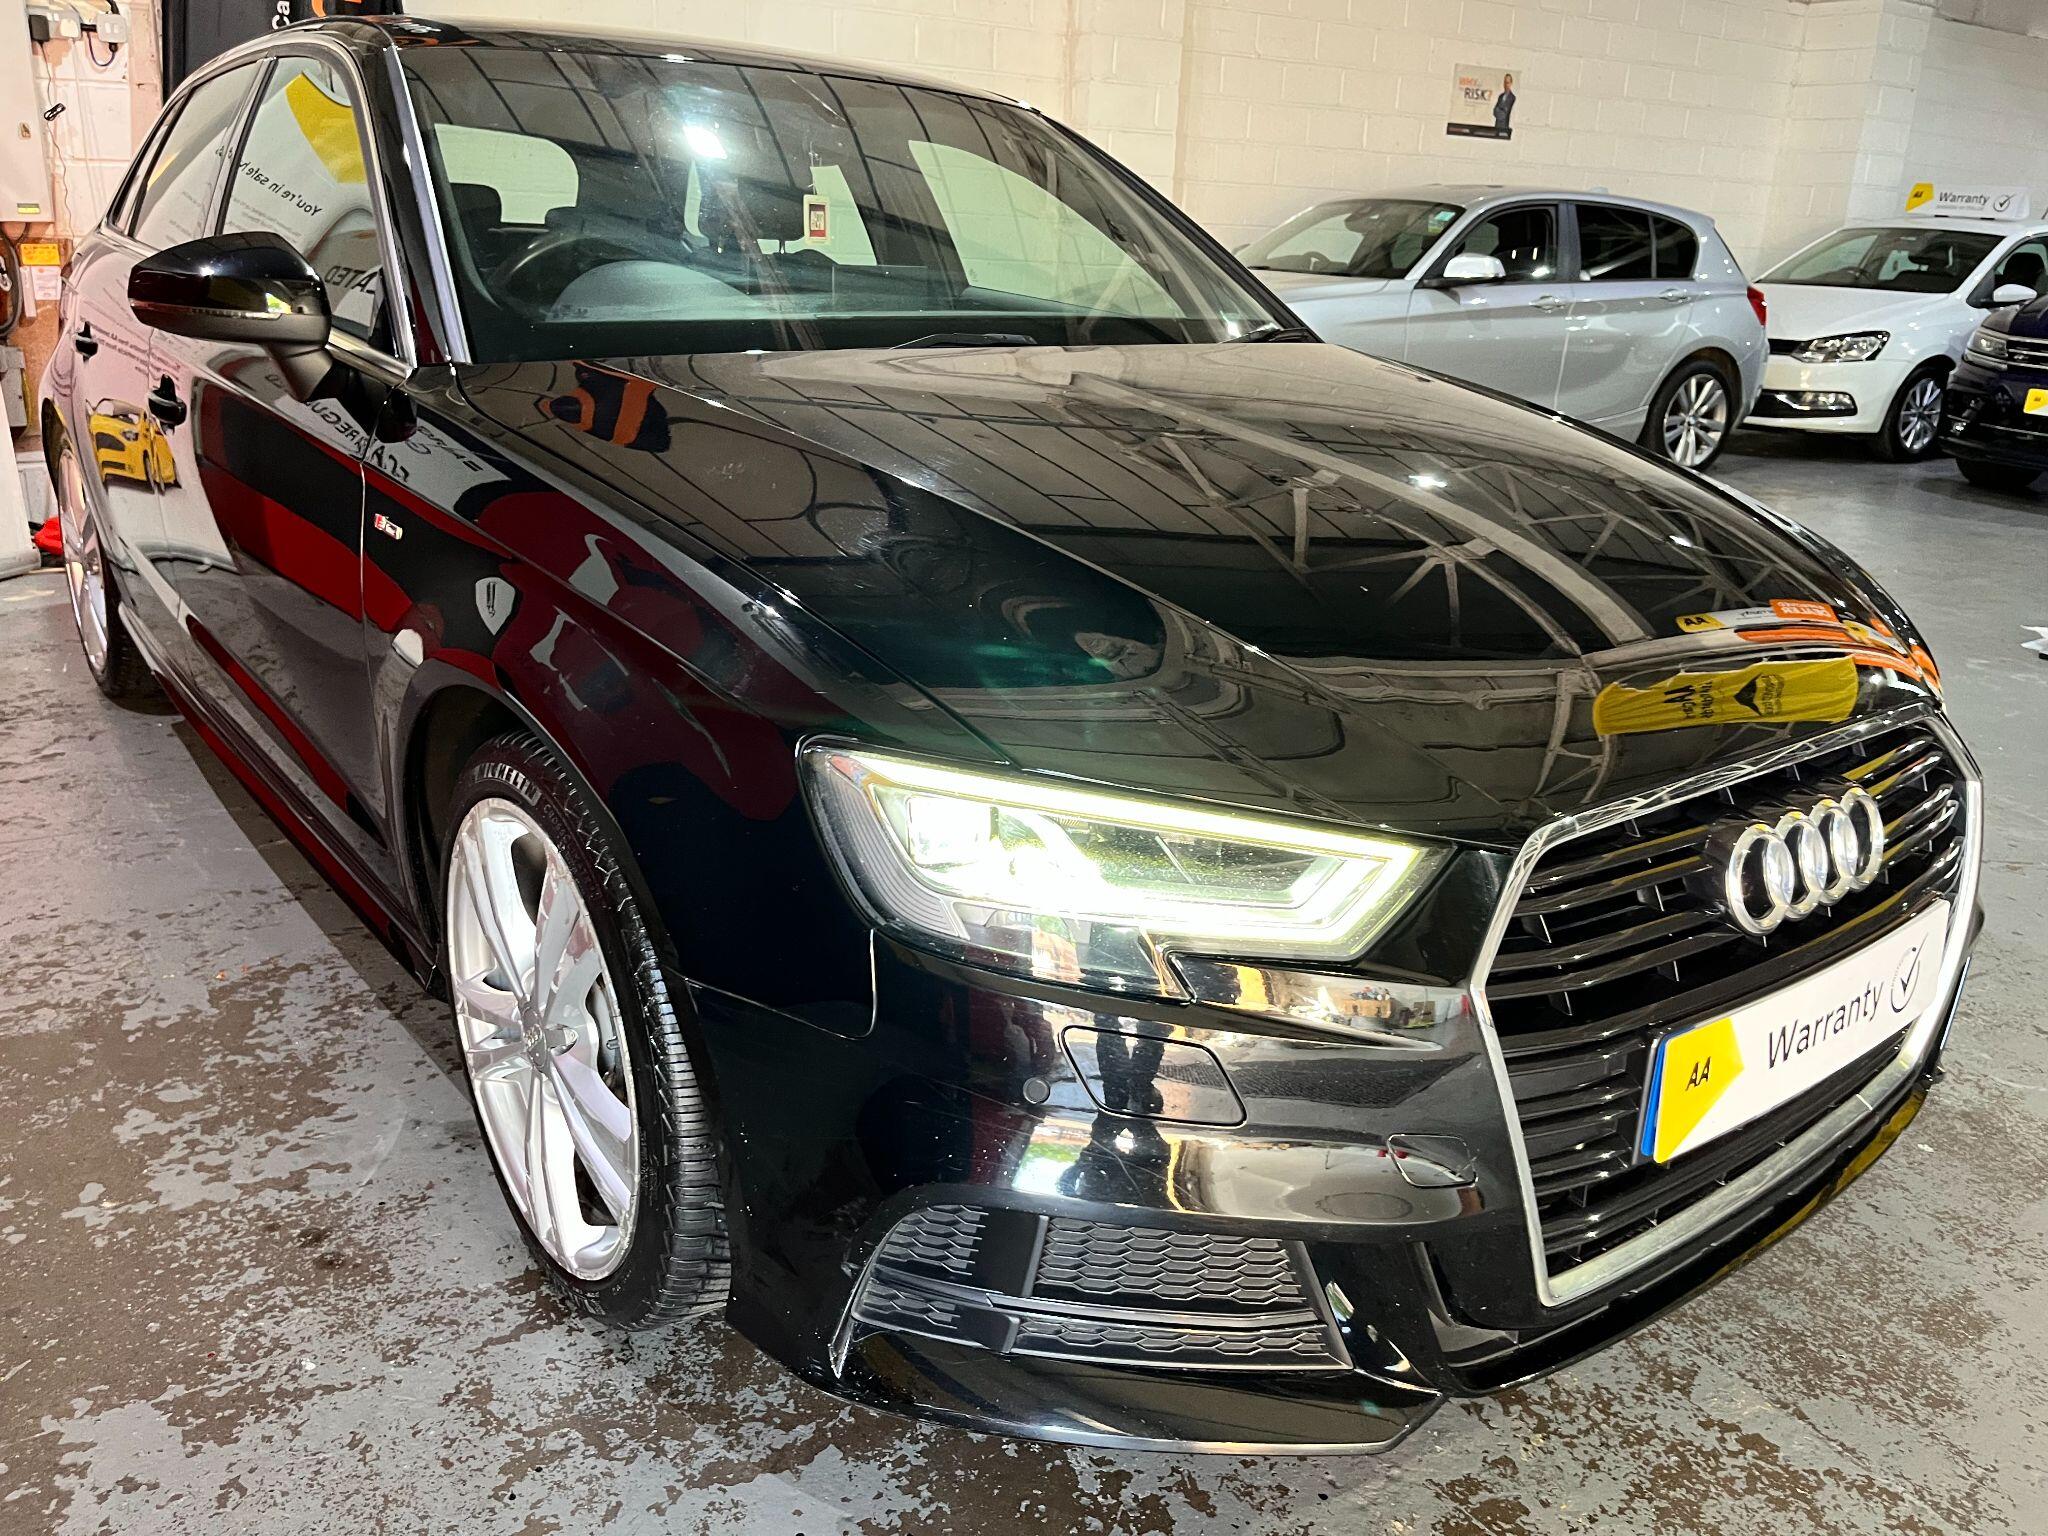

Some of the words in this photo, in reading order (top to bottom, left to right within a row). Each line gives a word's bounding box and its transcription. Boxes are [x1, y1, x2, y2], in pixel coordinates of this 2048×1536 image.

[1939, 192, 1990, 206] Warranty
[1685, 1057, 1711, 1091] AA
[1768, 979, 1885, 1069] Warranty
